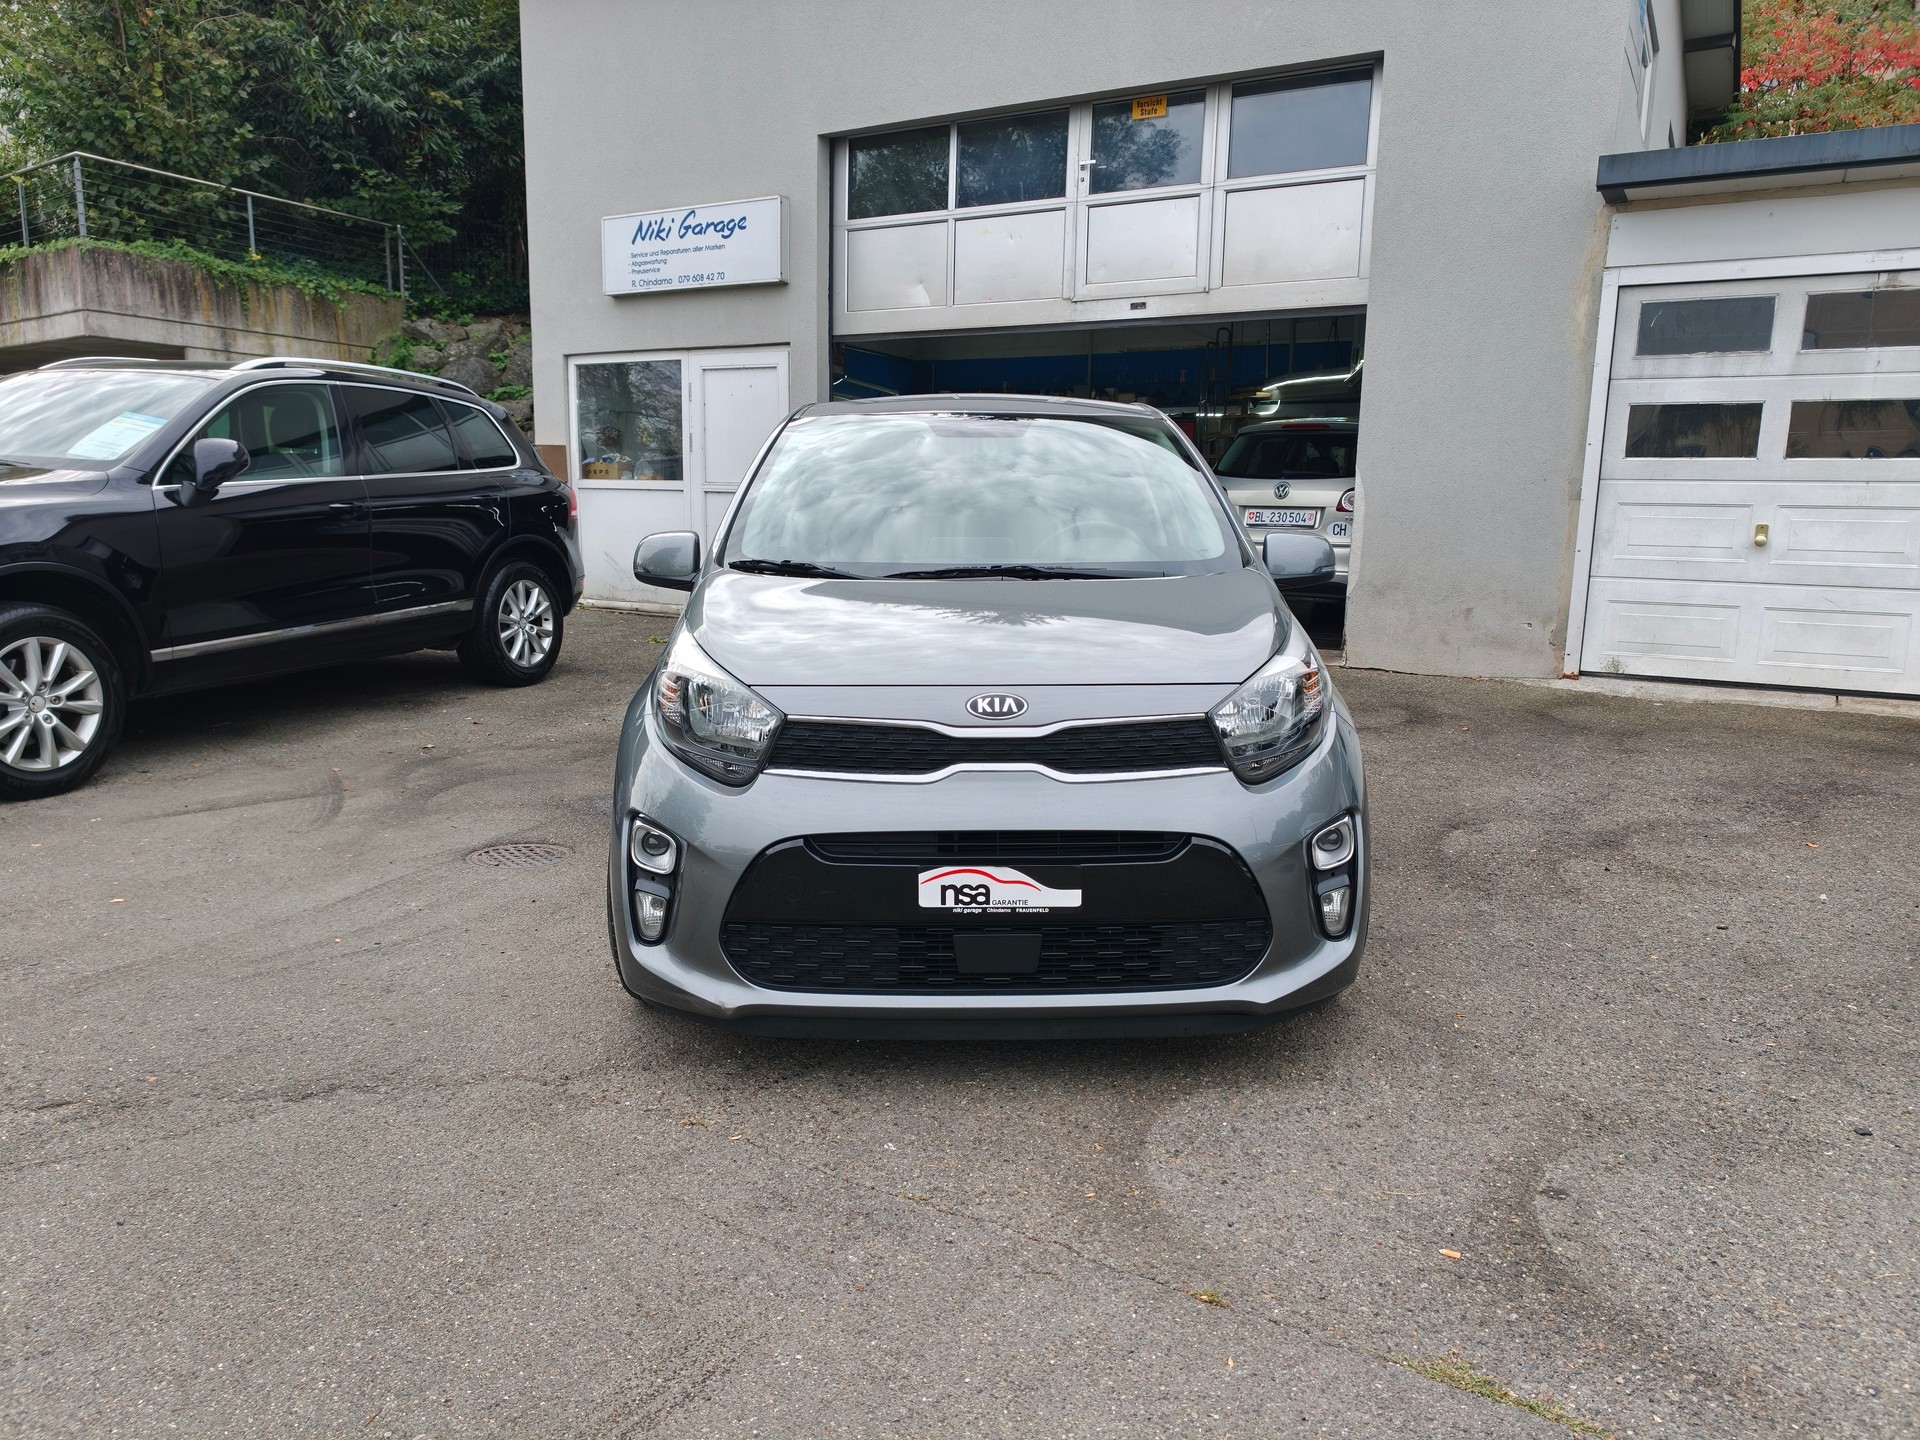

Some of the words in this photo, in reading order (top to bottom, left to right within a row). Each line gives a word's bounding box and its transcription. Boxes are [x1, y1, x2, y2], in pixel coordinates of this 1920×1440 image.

[1136, 98, 1163, 108] Vorsicht
[1140, 107, 1158, 116] Stufe
[631, 217, 675, 246] Niki
[677, 209, 747, 240] Garage
[660, 247, 691, 257] Reparaturen
[692, 245, 704, 253] aller
[631, 258, 667, 267] Abgaswartung
[631, 267, 661, 275] Pneuservice
[638, 278, 673, 287] Chindamo
[677, 275, 691, 284] 079
[691, 274, 704, 282] 608
[706, 272, 715, 281] 42
[716, 271, 725, 280] 70
[1332, 523, 1347, 536] CH
[976, 697, 1018, 713] KIA
[940, 884, 991, 906] nsa
